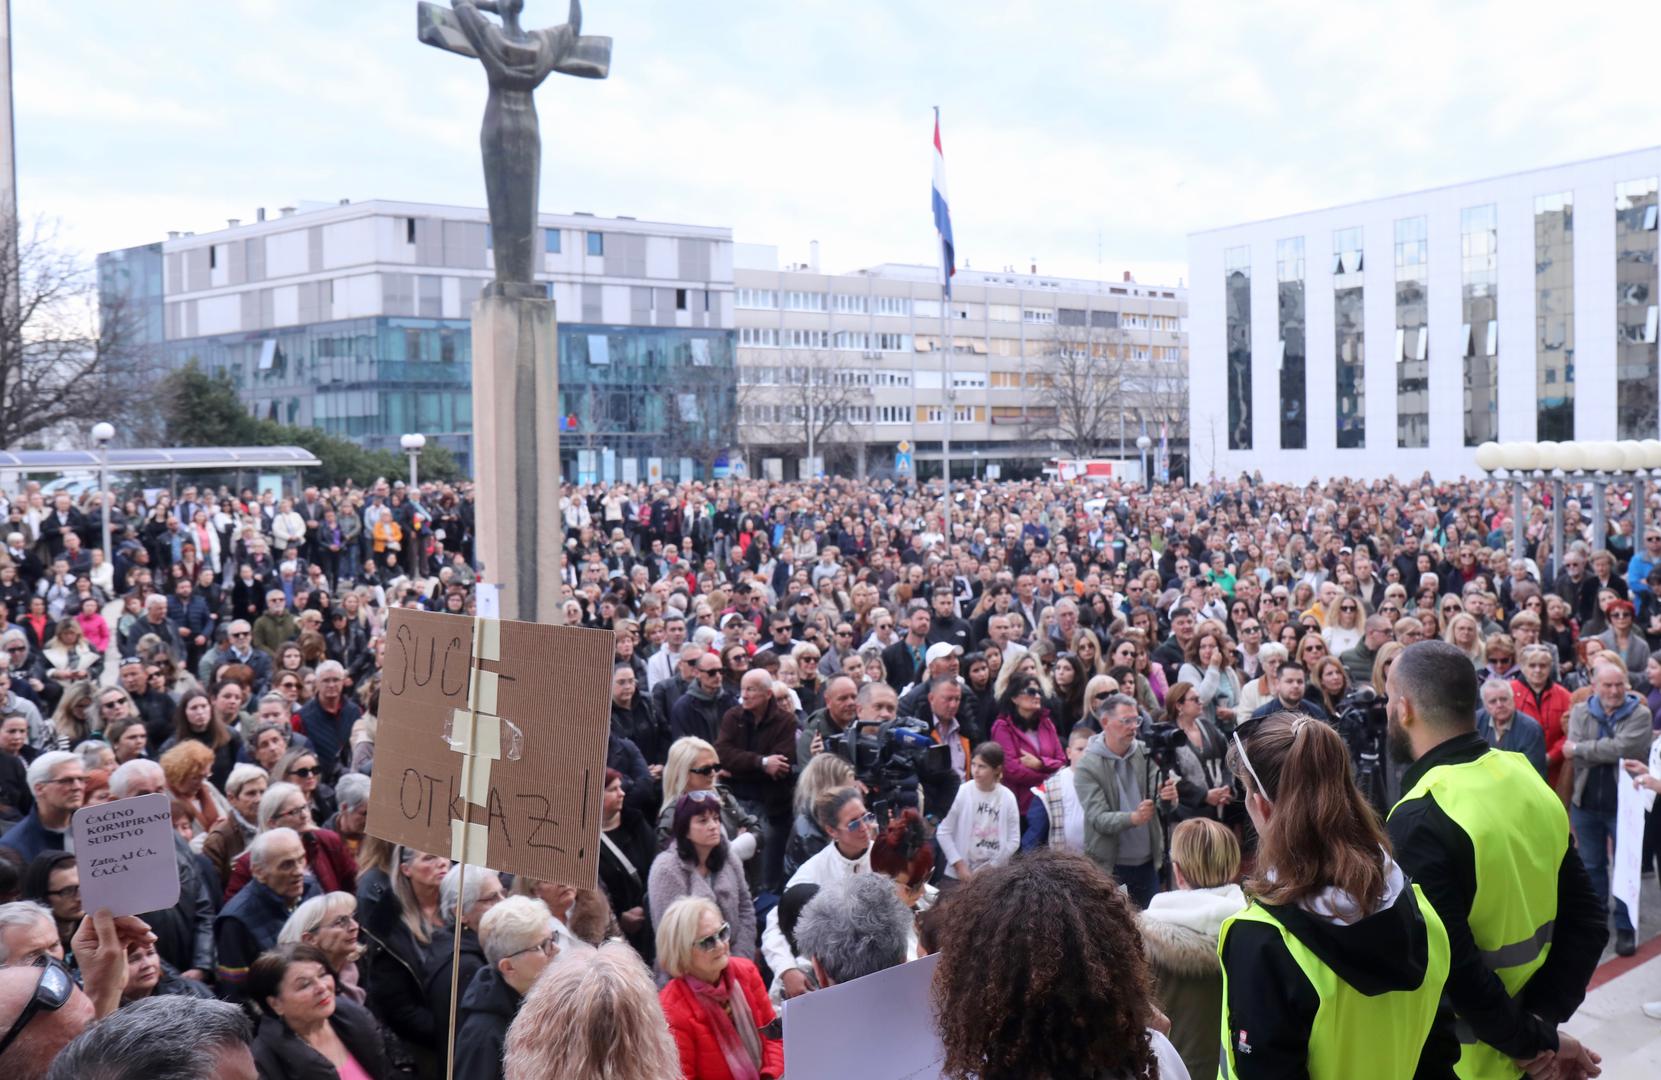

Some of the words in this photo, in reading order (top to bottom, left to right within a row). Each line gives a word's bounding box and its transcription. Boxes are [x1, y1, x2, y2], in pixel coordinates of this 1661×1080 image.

[87, 812, 170, 836] KORMPIRANO
[399, 767, 590, 859] OTKAZ!
[87, 828, 144, 846] SUDSTVO
